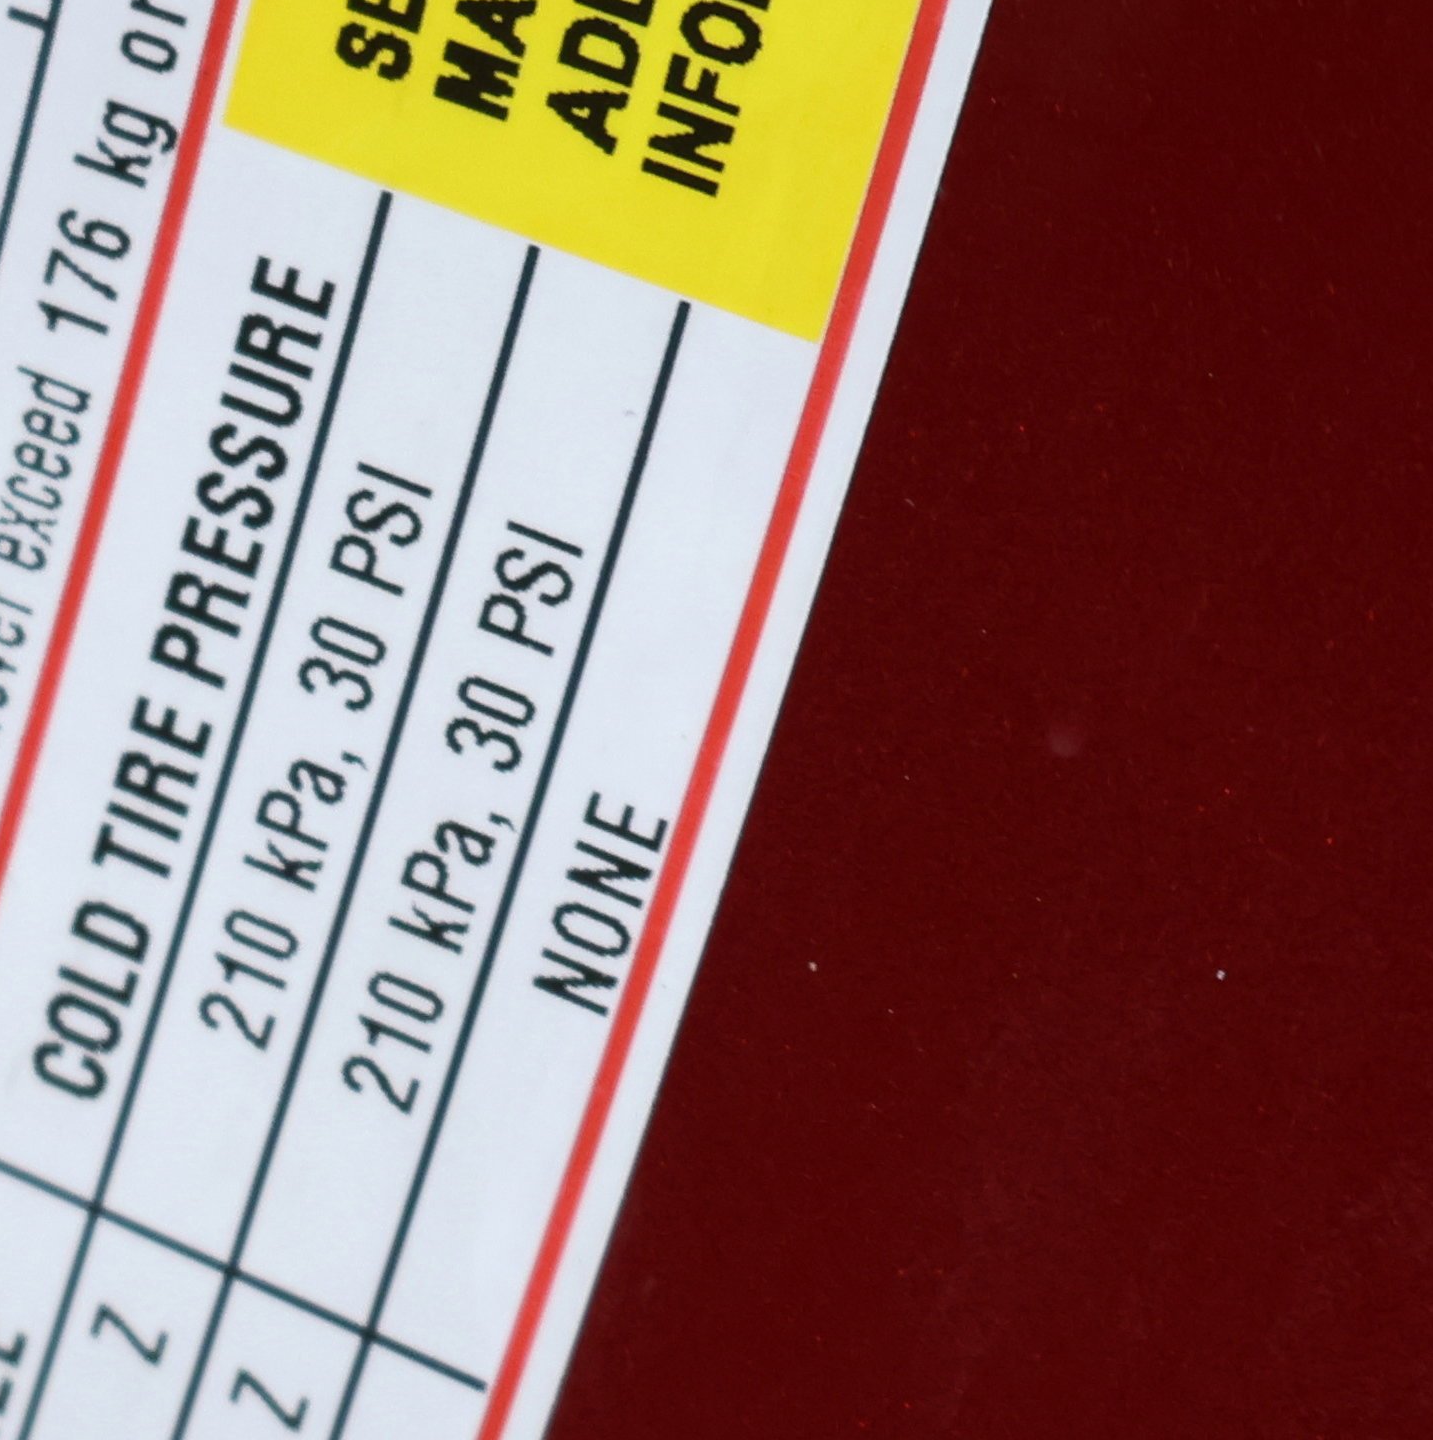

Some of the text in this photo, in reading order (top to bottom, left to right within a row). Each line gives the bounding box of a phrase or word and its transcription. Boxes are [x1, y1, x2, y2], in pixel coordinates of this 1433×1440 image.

[74, 98, 178, 188] kg
[38, 208, 132, 336] 176
[31, 254, 337, 1101] COLD TIRE PRESSURE
[199, 462, 434, 1051] 210 kPa, 30 PSI
[342, 520, 585, 1115] 210 kPa, 30 PSI
[532, 793, 669, 1017] NONE
[91, 1304, 169, 1367] Z
[231, 1369, 309, 1433] Z
